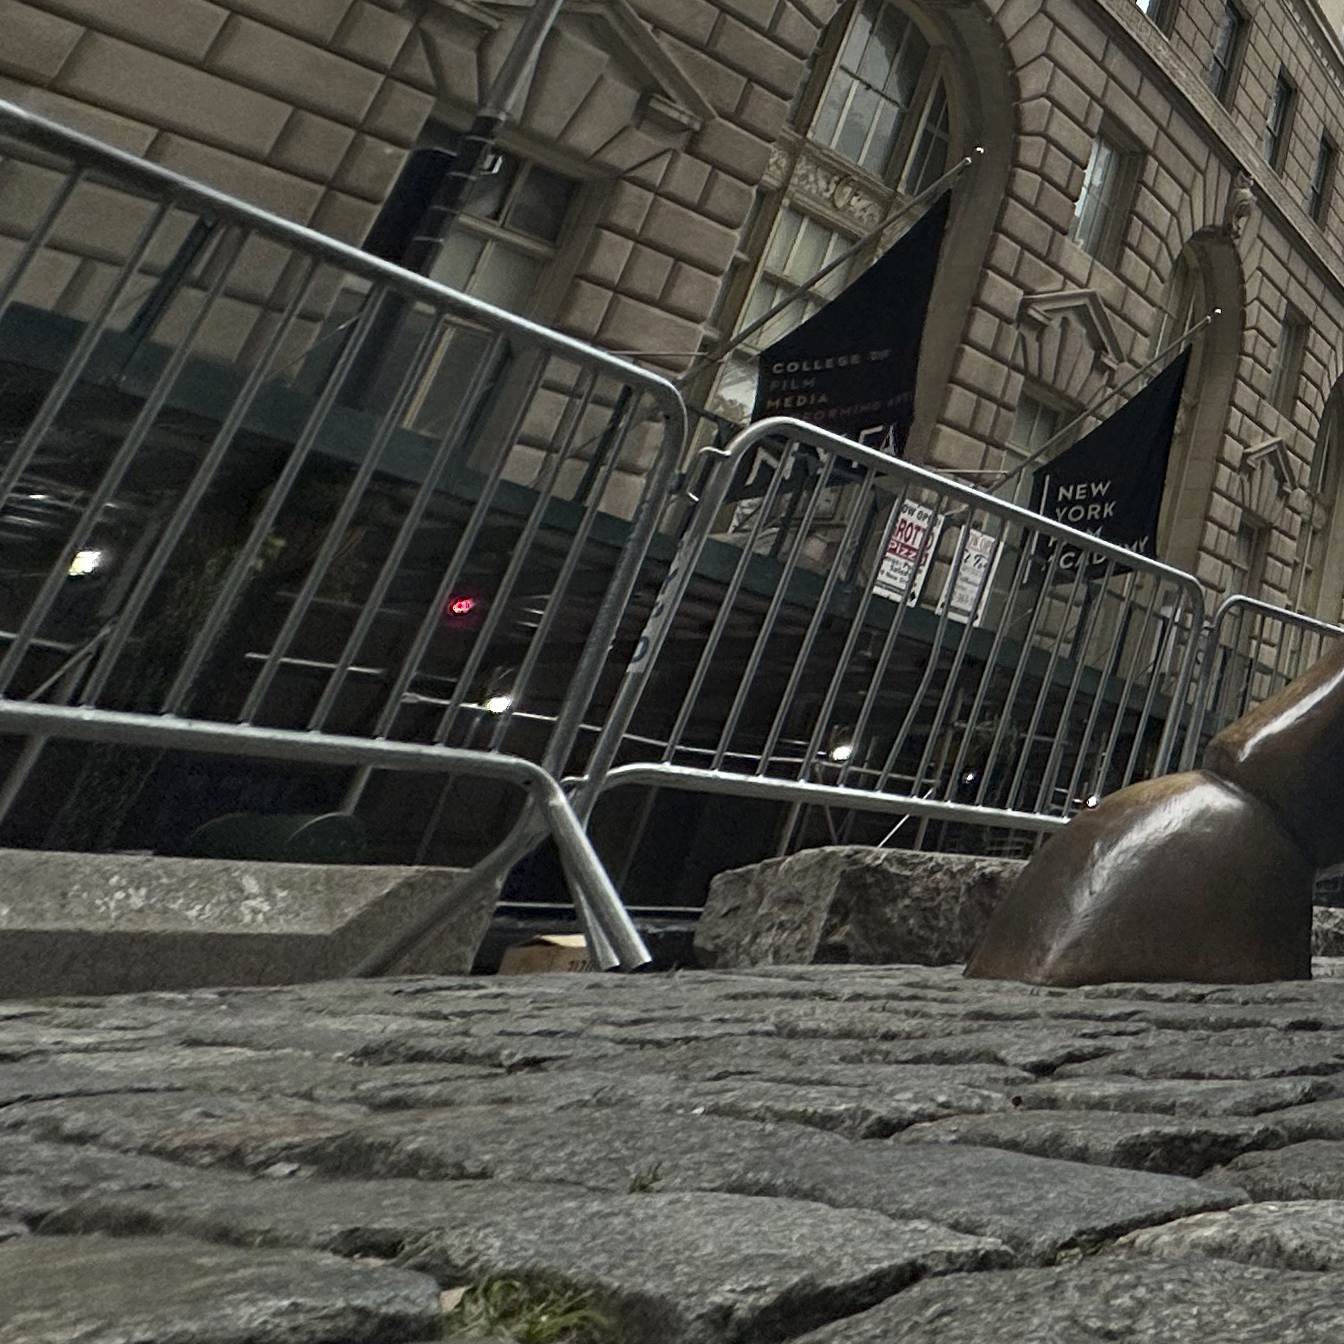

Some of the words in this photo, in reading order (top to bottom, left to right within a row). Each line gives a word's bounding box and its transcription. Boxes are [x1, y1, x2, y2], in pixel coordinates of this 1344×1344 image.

[772, 354, 862, 374] COLLEGE
[765, 393, 829, 409] MEDIA
[1056, 480, 1111, 502] NEW
[1055, 500, 1117, 523] YORK
